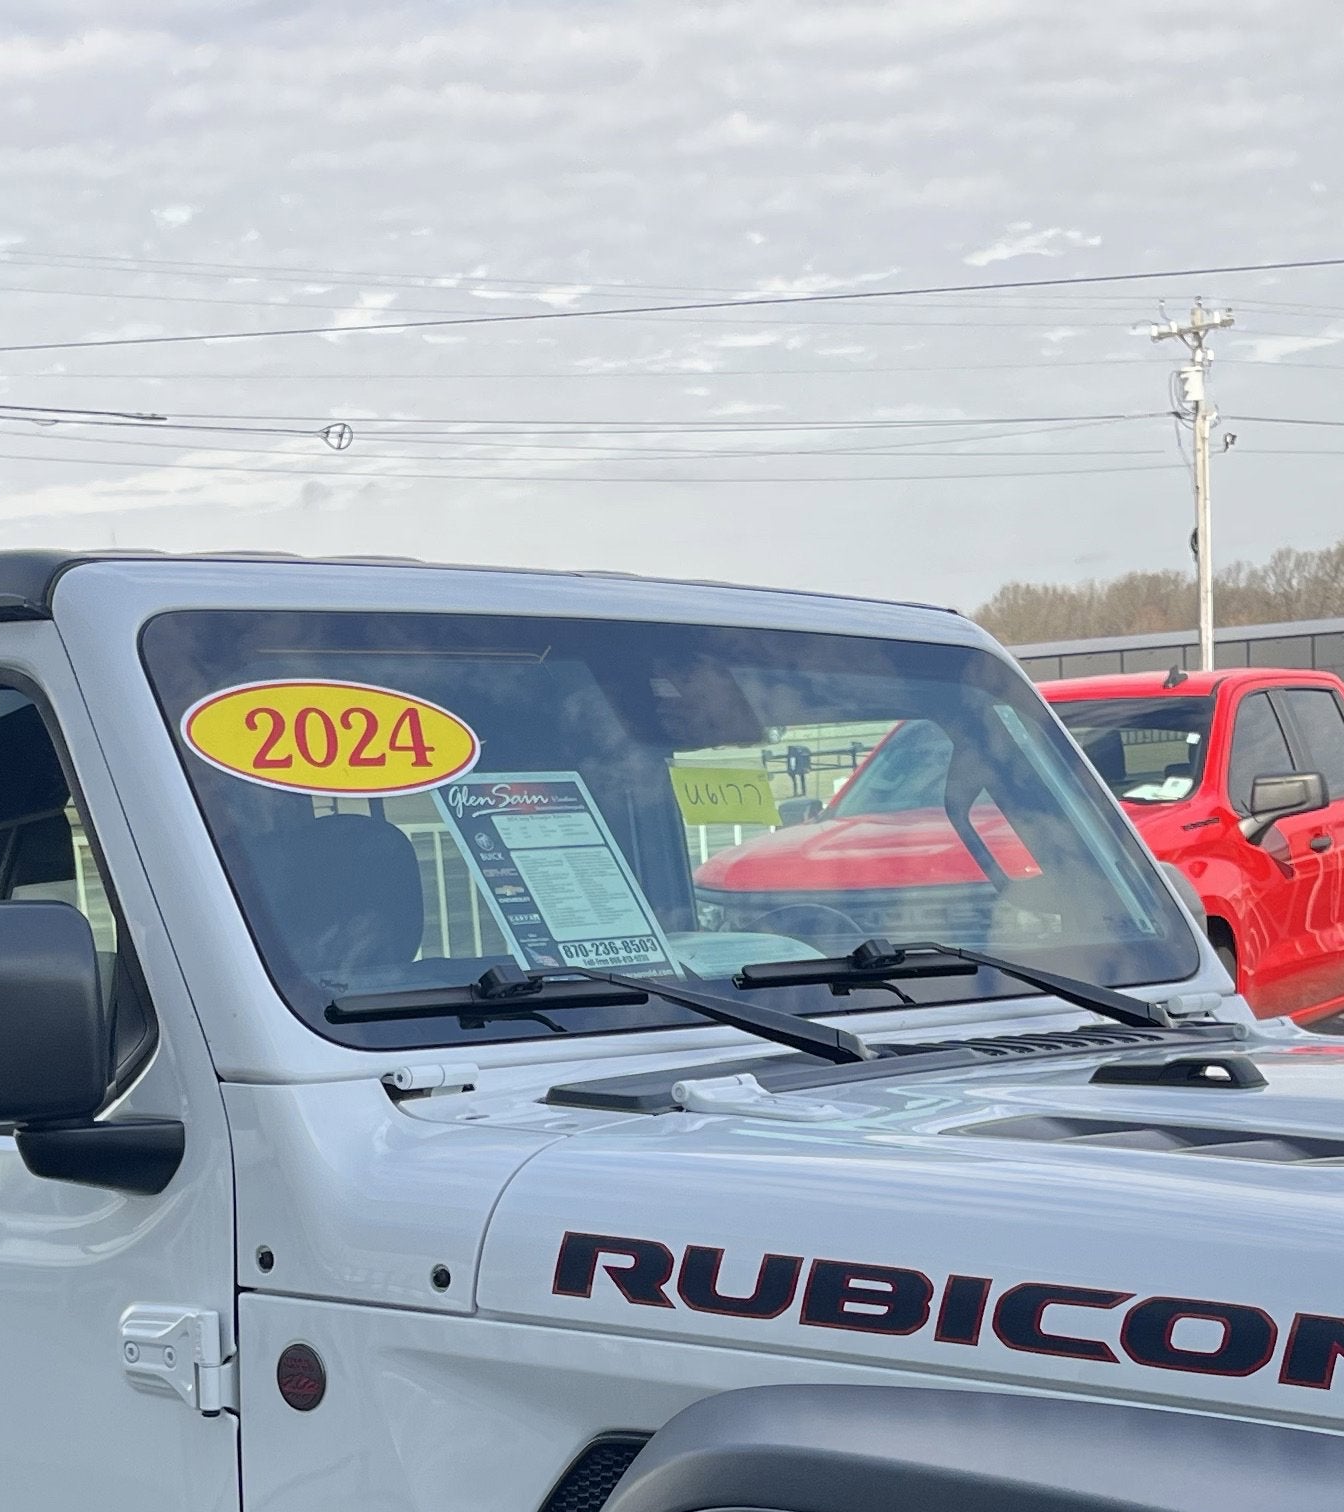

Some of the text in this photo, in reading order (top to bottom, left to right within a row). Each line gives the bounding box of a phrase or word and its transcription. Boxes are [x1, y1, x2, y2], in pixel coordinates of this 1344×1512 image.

[245, 706, 435, 769] 2024
[449, 784, 549, 818] Glen Sain
[562, 938, 657, 960] 870-236-8503
